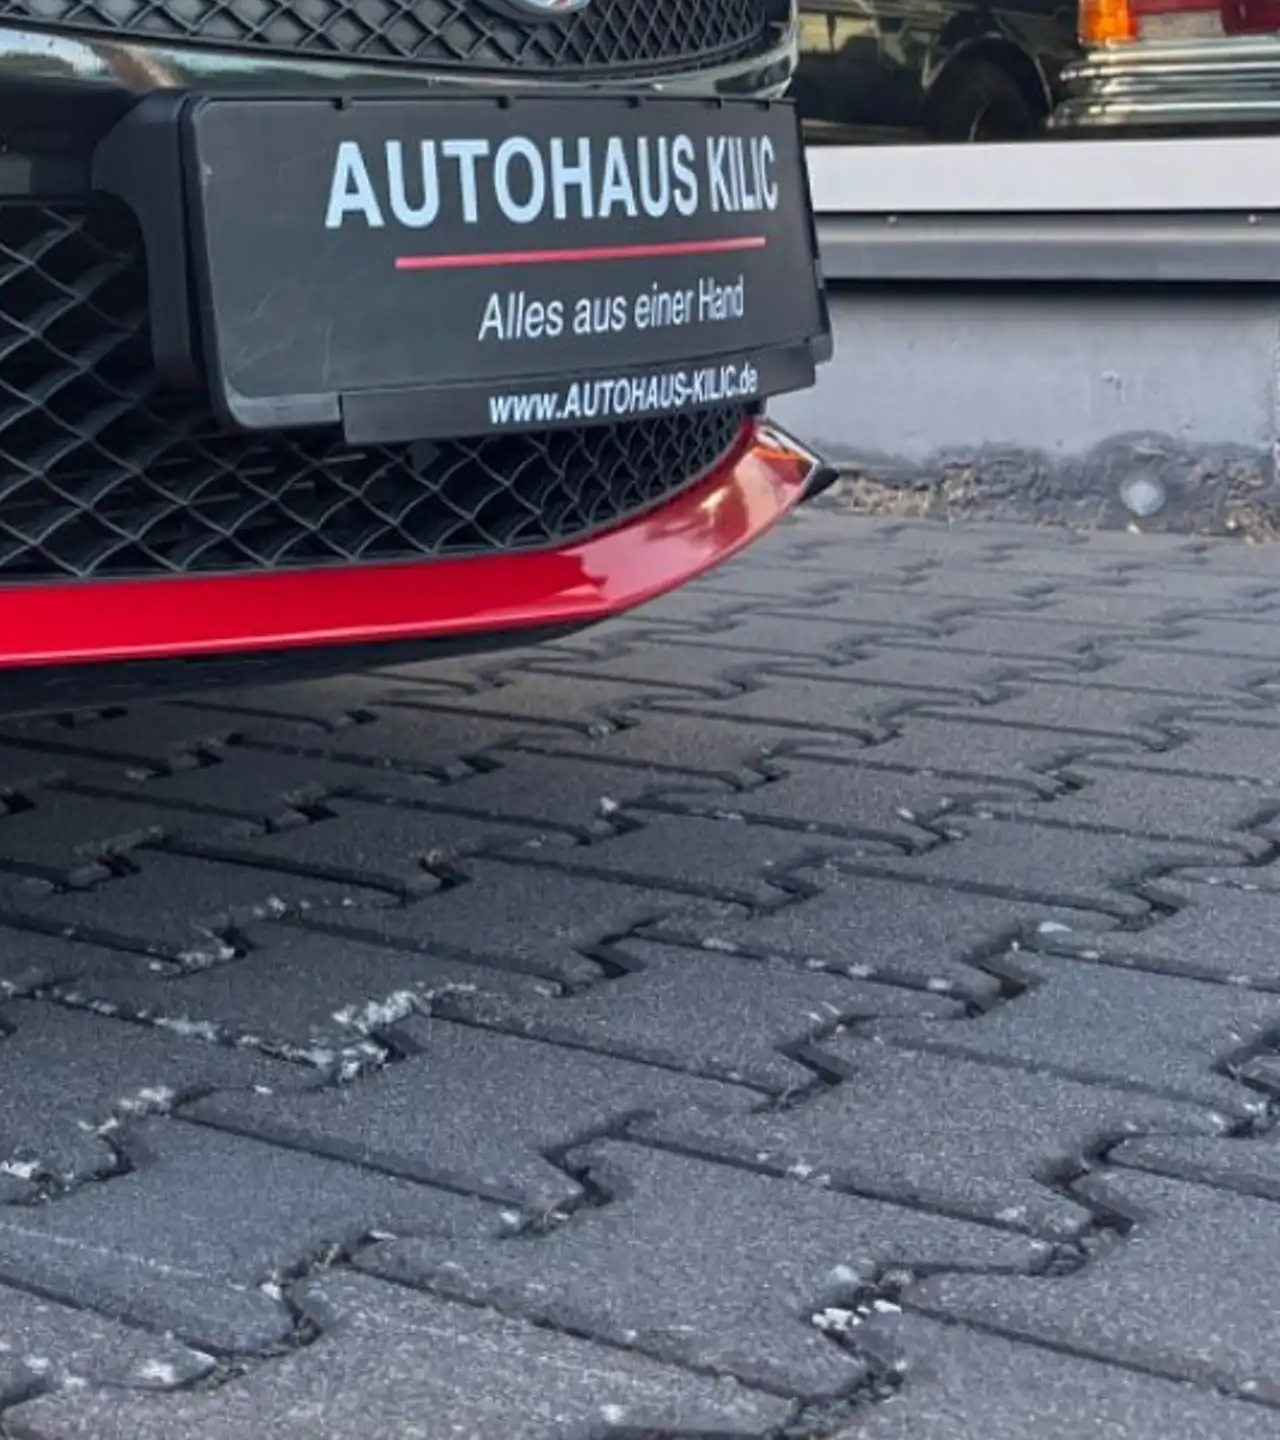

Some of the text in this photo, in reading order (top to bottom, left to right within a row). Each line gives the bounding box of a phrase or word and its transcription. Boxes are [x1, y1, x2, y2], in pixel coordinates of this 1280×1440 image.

[324, 134, 778, 229] AUTOHAUS KILIC
[478, 274, 744, 342] Alles aus einer Hand
[490, 362, 758, 424] www.AUTOHAUS-KILIC.de
